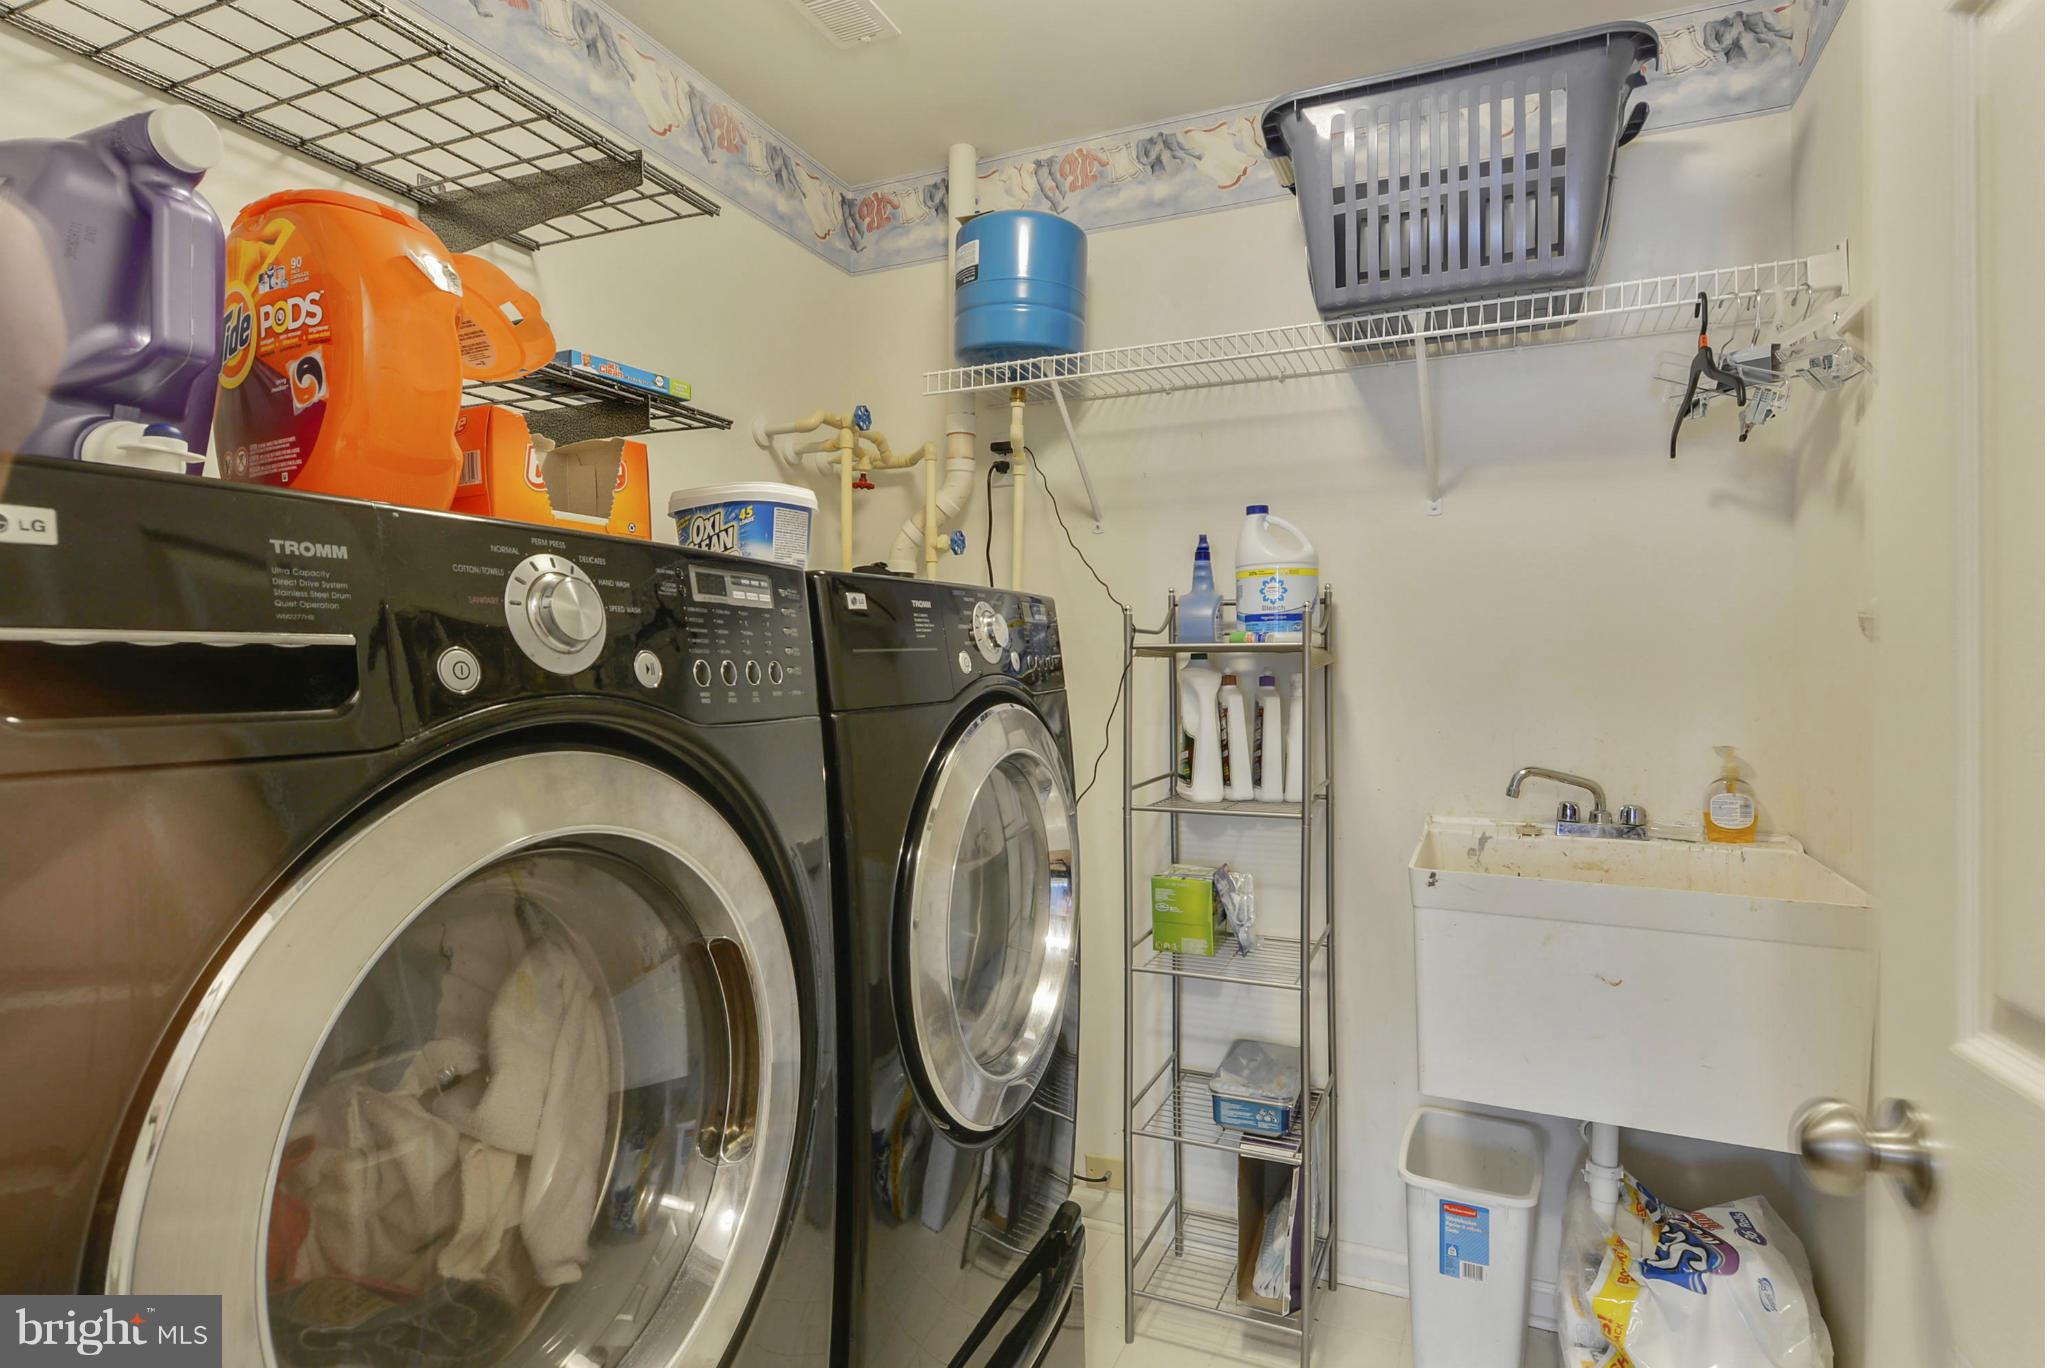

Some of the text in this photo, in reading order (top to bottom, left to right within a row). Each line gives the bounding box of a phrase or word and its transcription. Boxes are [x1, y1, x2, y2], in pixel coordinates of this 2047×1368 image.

[290, 256, 302, 269] 90
[260, 291, 323, 338] PODS
[740, 505, 754, 519] 45
[18, 519, 47, 533] LG
[690, 511, 721, 544] OXI
[269, 538, 348, 560] TROMM
[490, 544, 520, 555] NORMAL
[531, 537, 566, 549] PERM PRESS
[579, 555, 606, 566] DELICATES
[271, 567, 330, 579] Ultra Capacity
[452, 563, 505, 577] COTTON/TOWELS
[272, 577, 349, 590] Direct Drive System
[598, 579, 630, 589] HAND WASH
[273, 588, 352, 601] Stainless Steel Drum
[274, 599, 341, 610] Quiet Operation
[609, 605, 642, 615] SPEED WASH
